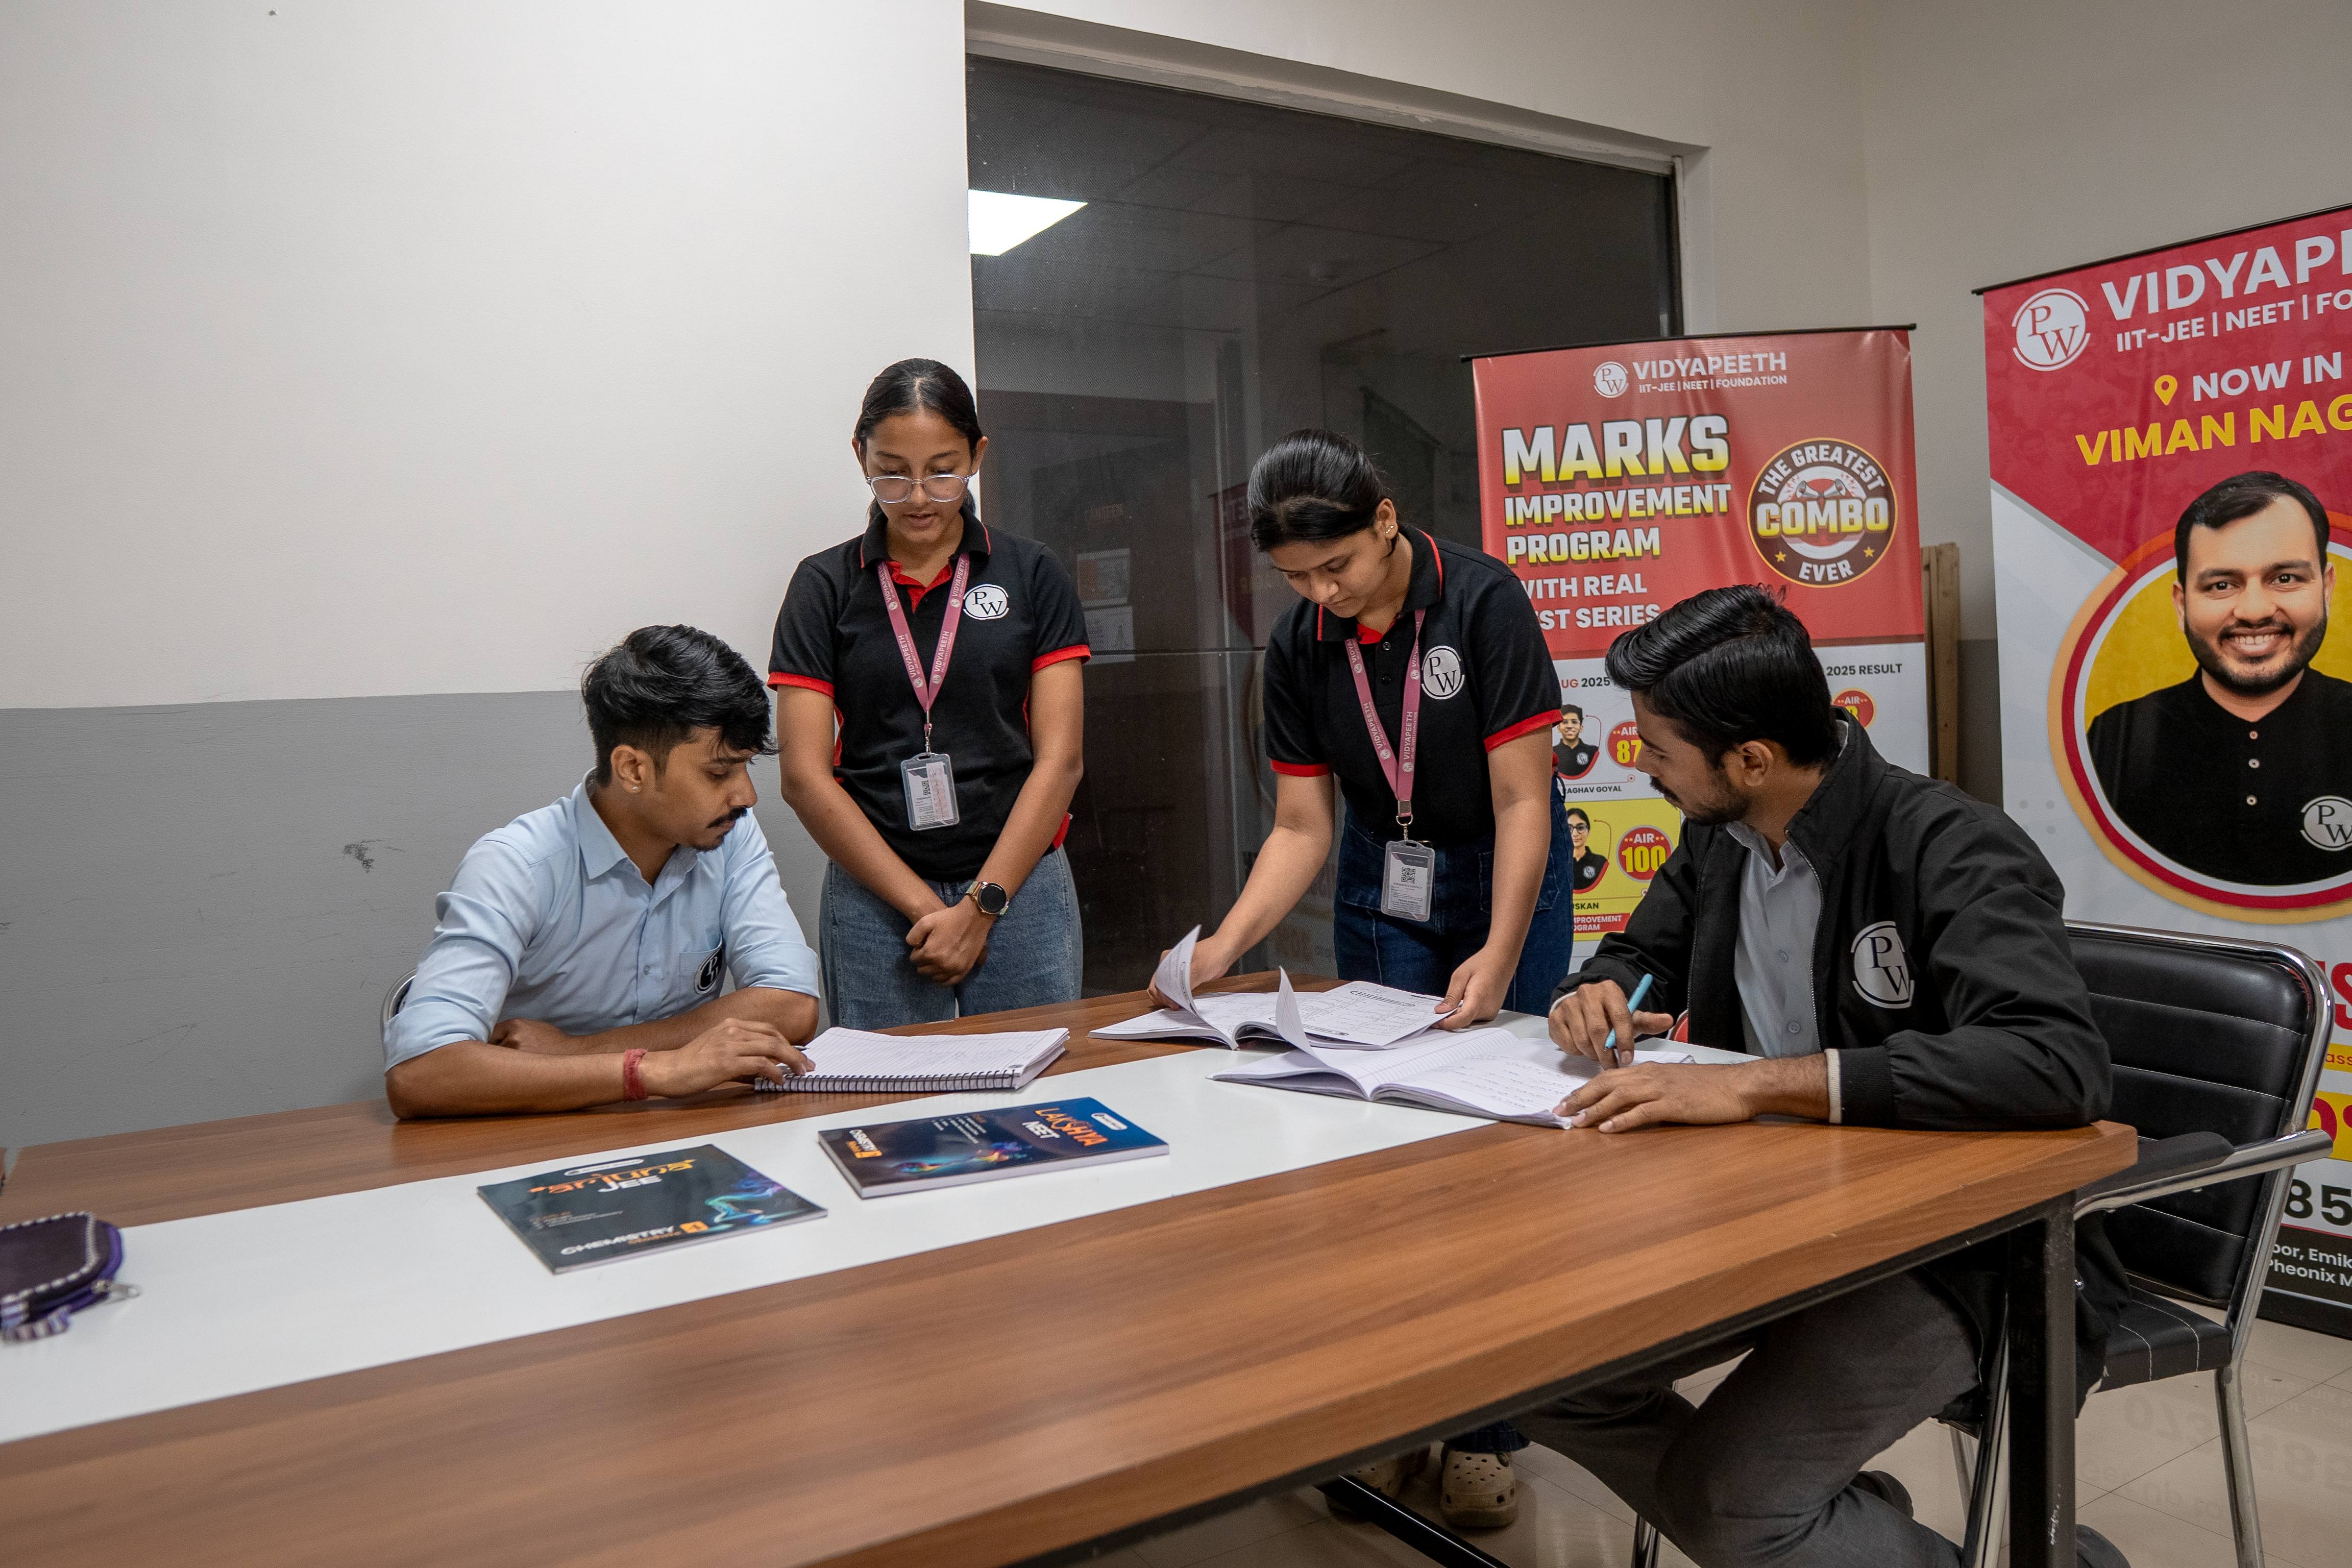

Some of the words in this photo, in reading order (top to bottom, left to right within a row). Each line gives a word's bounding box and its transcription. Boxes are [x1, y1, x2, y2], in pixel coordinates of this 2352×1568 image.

[2117, 317, 2205, 352] IIT-JEE
[2225, 300, 2295, 331] NEET
[1632, 352, 1786, 380] VIDYAPEETH
[2193, 360, 2292, 402] NOW
[2303, 351, 2342, 384] IN
[1639, 383, 1675, 393] IIT-JEE
[1682, 380, 1708, 390] NEET
[1716, 375, 1787, 388] FOUNDATION
[2075, 411, 2235, 465] VIMAN
[2249, 394, 2352, 443] NAG
[1502, 415, 1730, 485] MARKS
[1758, 458, 1793, 495] THE
[1790, 444, 1885, 491] GREATEST
[1505, 484, 1732, 526] IMPROVEMENT
[1756, 497, 1889, 537] COMBO
[1506, 527, 1660, 565] PROGRAM
[952, 559, 965, 597] VIDYAPEETH
[1583, 573, 1648, 596] REAL
[1798, 559, 1854, 581] EVER
[972, 592, 1003, 616] PW
[1535, 609, 1571, 630] ST
[1576, 604, 1660, 628] SERIES
[898, 634, 916, 678] VIDYAPEETH
[934, 631, 949, 672] VIDYAPEETH
[1429, 656, 1457, 693] PW
[1561, 679, 1578, 688] UG
[1581, 677, 1611, 688] 2025
[1826, 666, 1856, 676] 2025
[1859, 664, 1903, 675] RESULT
[1845, 696, 1860, 704] AIR
[1363, 702, 1383, 749] VIDYAPEETH
[1403, 711, 1413, 760] VIDYAPEETH
[1633, 833, 1654, 844] AIR
[1622, 845, 1667, 873] 100
[1574, 915, 1622, 923] PROVEMENT
[1021, 1120, 1061, 1139] NEET
[598, 1175, 663, 1193] JEE
